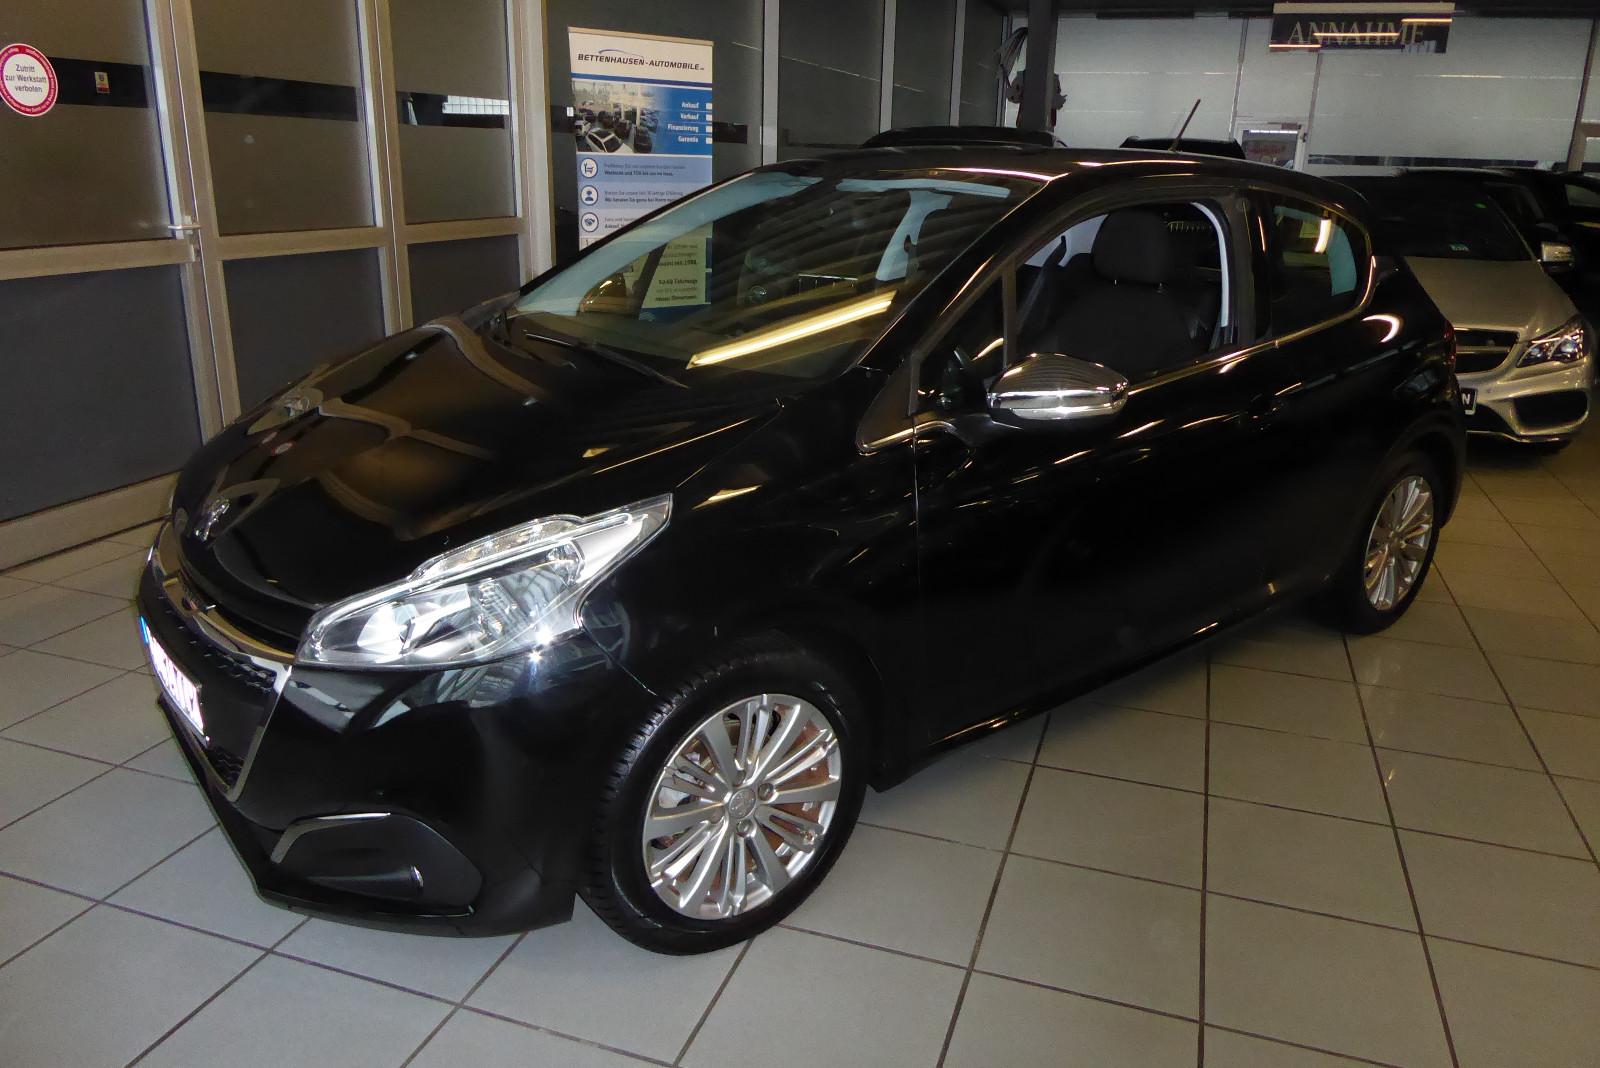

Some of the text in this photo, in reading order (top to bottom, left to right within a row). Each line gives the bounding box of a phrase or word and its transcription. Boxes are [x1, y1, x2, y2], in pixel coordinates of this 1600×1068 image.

[1288, 20, 1424, 45] ANNAHME
[578, 53, 704, 70] BETTENHAUSEN-AUTOMOBILE
[15, 64, 35, 73] Zutritt
[17, 74, 47, 83] Werkstatt
[15, 85, 43, 93] verboten
[682, 101, 699, 109] Ankauf
[667, 123, 699, 133] Finanzierung
[678, 135, 699, 143] Garantie
